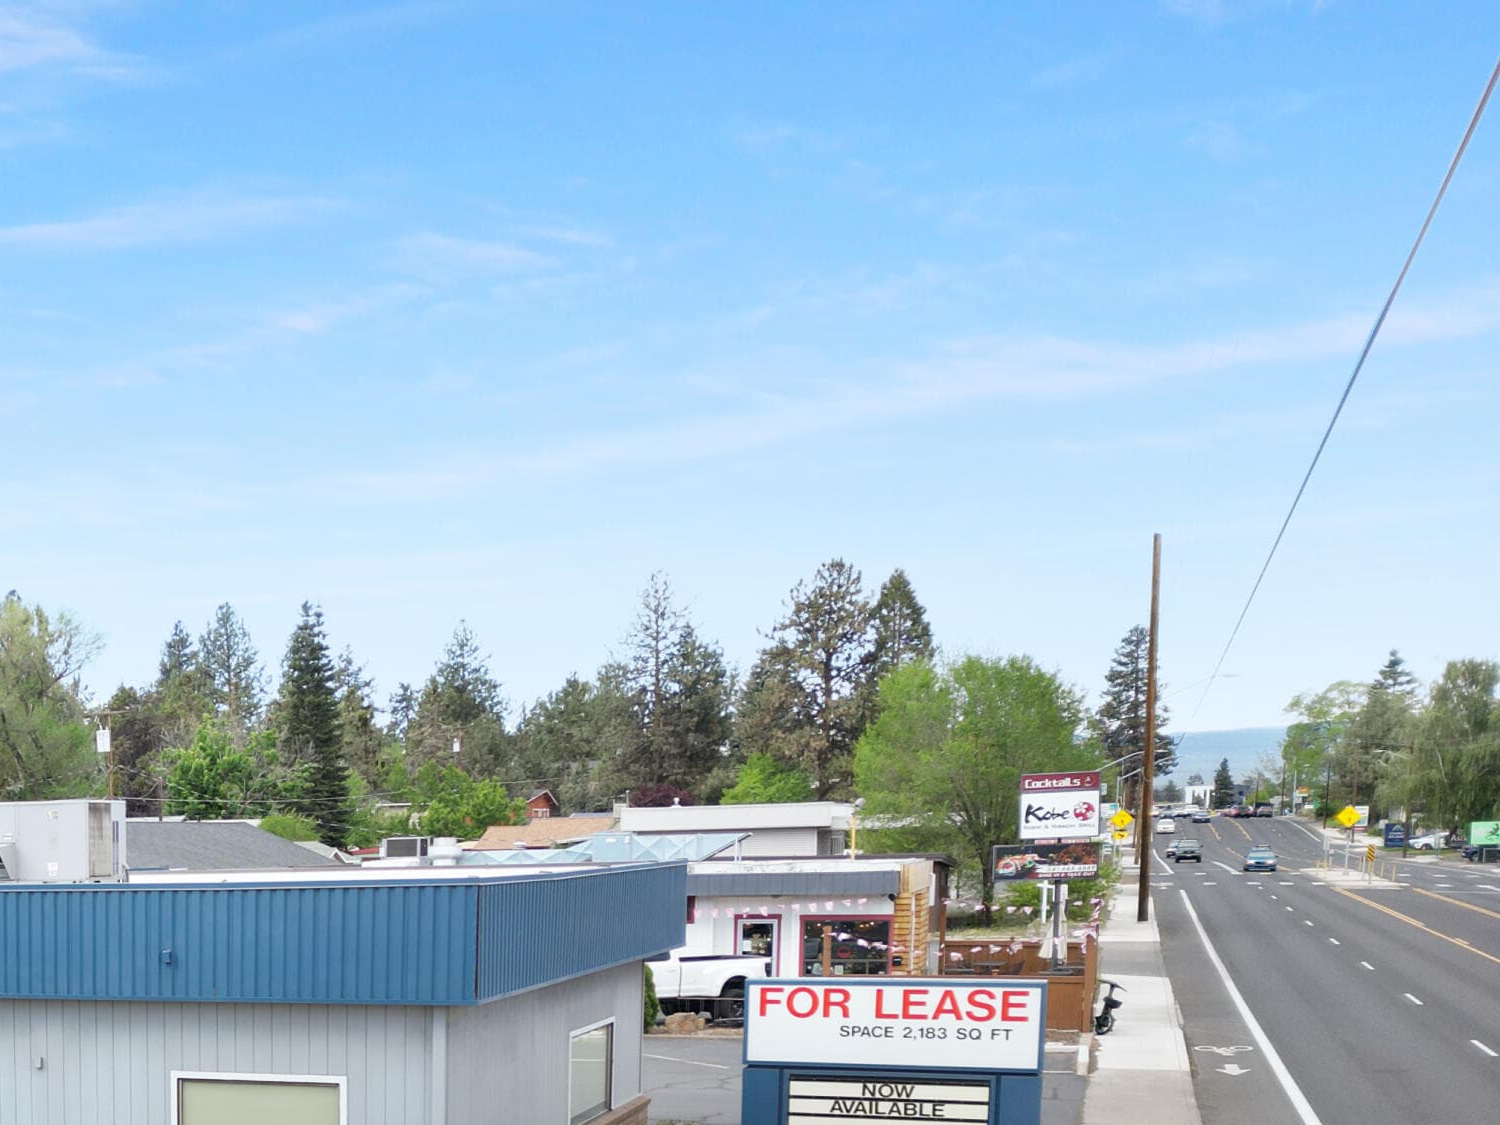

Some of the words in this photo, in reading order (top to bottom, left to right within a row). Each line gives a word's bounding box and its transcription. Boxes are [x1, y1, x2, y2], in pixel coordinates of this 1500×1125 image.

[1025, 777, 1081, 789] Cocktails
[1025, 804, 1069, 823] Kobe
[759, 987, 850, 1018] FOR
[875, 989, 1030, 1022] LEASE
[839, 1025, 894, 1038] SPACE
[903, 1027, 947, 1040] 2,183
[956, 1028, 982, 1041] SQ
[991, 1029, 1012, 1041] FT
[862, 1083, 915, 1098] NOW
[830, 1101, 944, 1117] AVAILABLE
